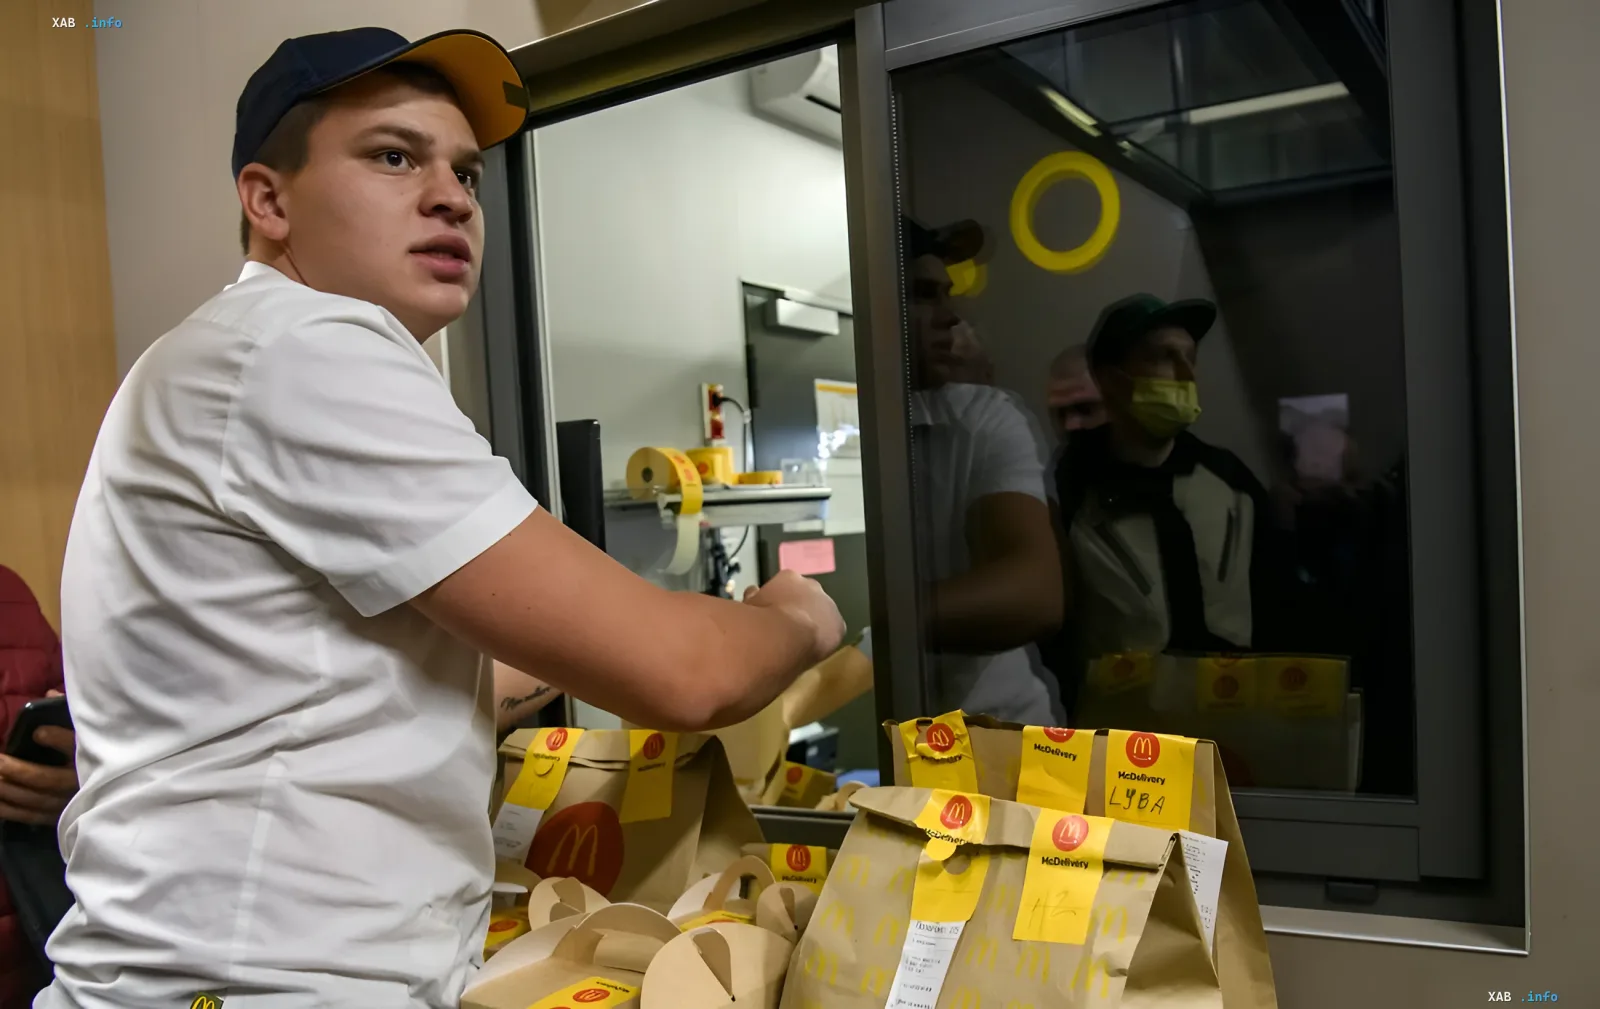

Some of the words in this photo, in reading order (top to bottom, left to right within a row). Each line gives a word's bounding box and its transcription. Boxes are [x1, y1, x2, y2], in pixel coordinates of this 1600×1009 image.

[1033, 743, 1078, 761] McDelivery
[1118, 771, 1166, 785] McDelivery
[1041, 856, 1089, 869] McDelivery
